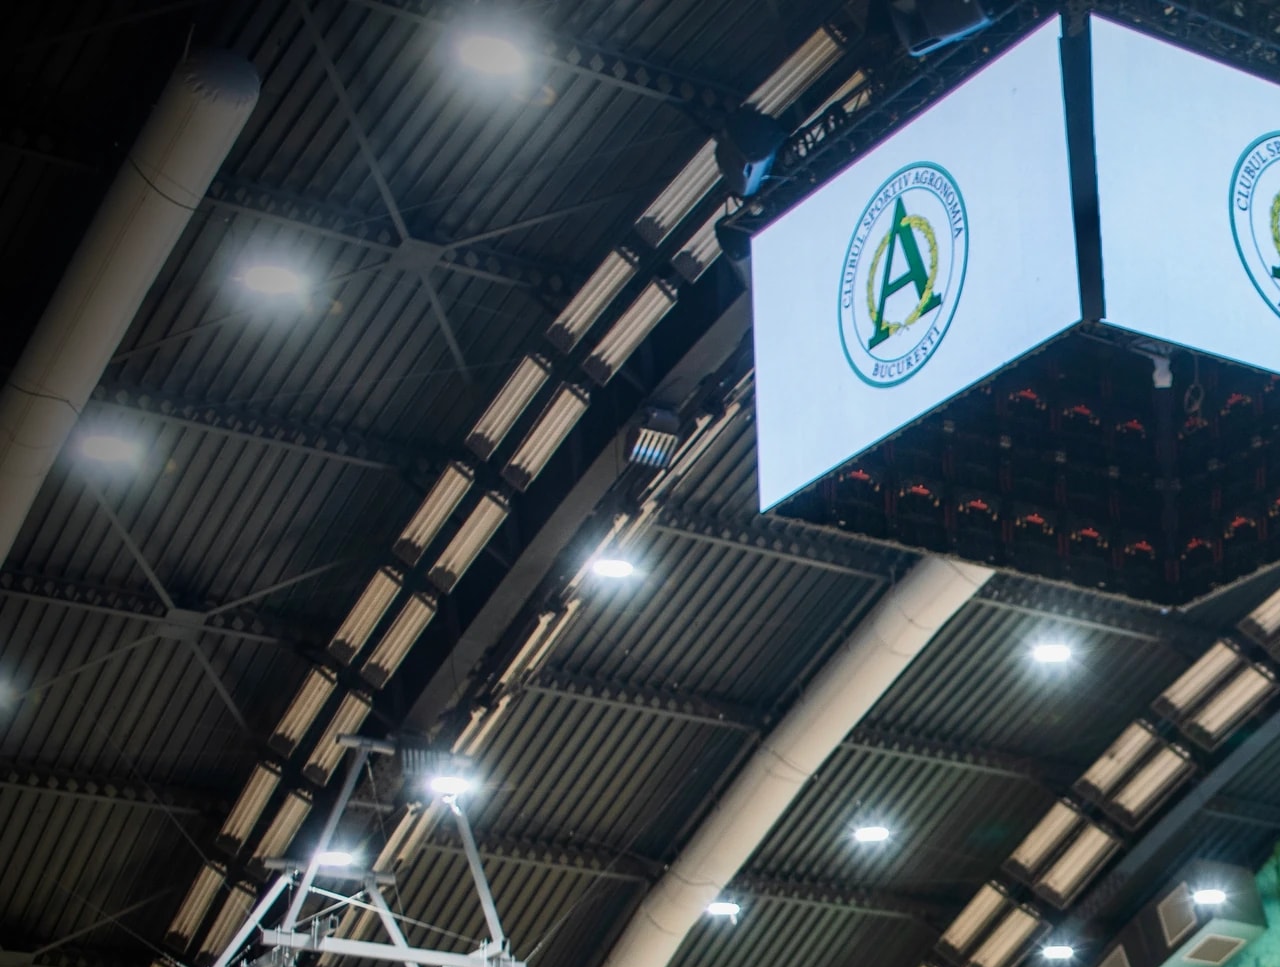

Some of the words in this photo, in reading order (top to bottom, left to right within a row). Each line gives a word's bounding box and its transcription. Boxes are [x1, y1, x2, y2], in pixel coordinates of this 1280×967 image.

[1236, 152, 1269, 212] CLUBUL
[842, 230, 867, 310] CLUBUL
[863, 171, 914, 231] SPORTIV
[912, 168, 965, 240] AGRONOMIA
